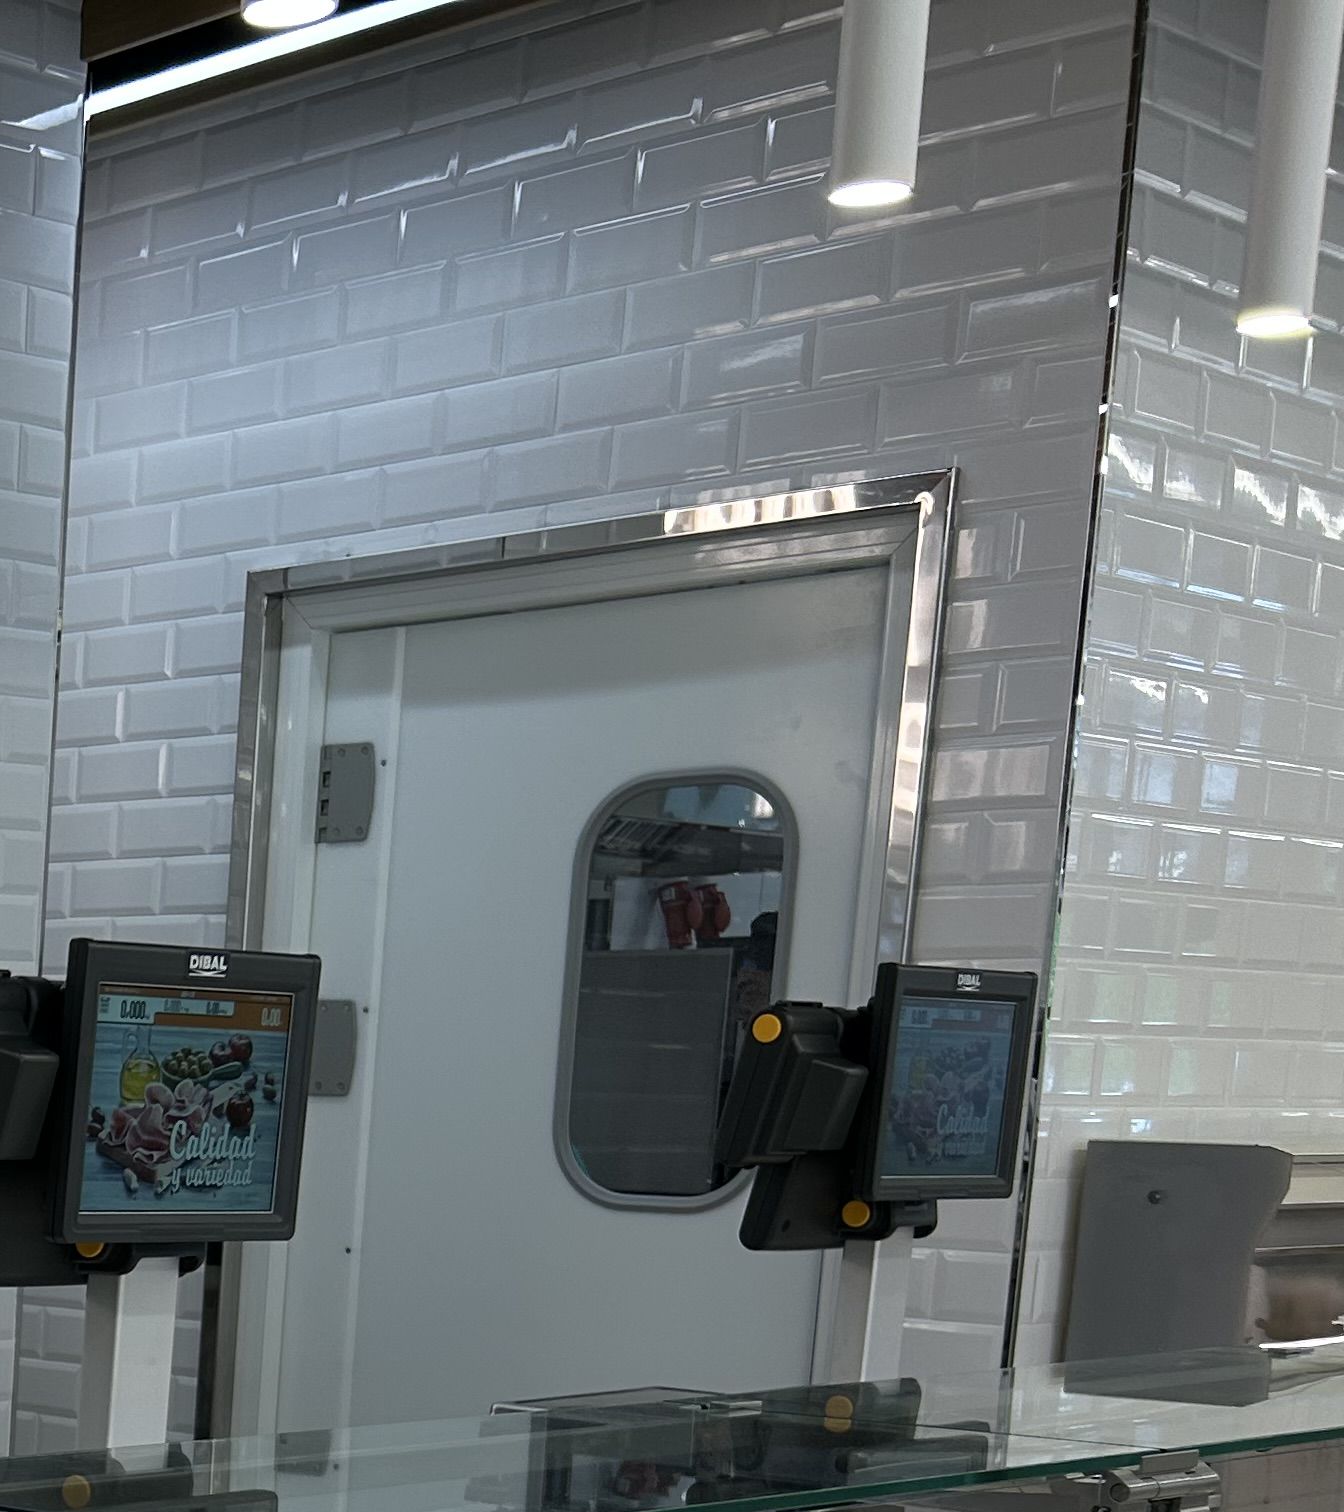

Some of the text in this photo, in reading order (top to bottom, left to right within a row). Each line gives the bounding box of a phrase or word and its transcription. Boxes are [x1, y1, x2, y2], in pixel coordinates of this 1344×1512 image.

[189, 955, 227, 971] DIBAL
[958, 974, 981, 986] DIBAL
[170, 1120, 256, 1160] Calidad
[187, 1161, 252, 1186] variedad
